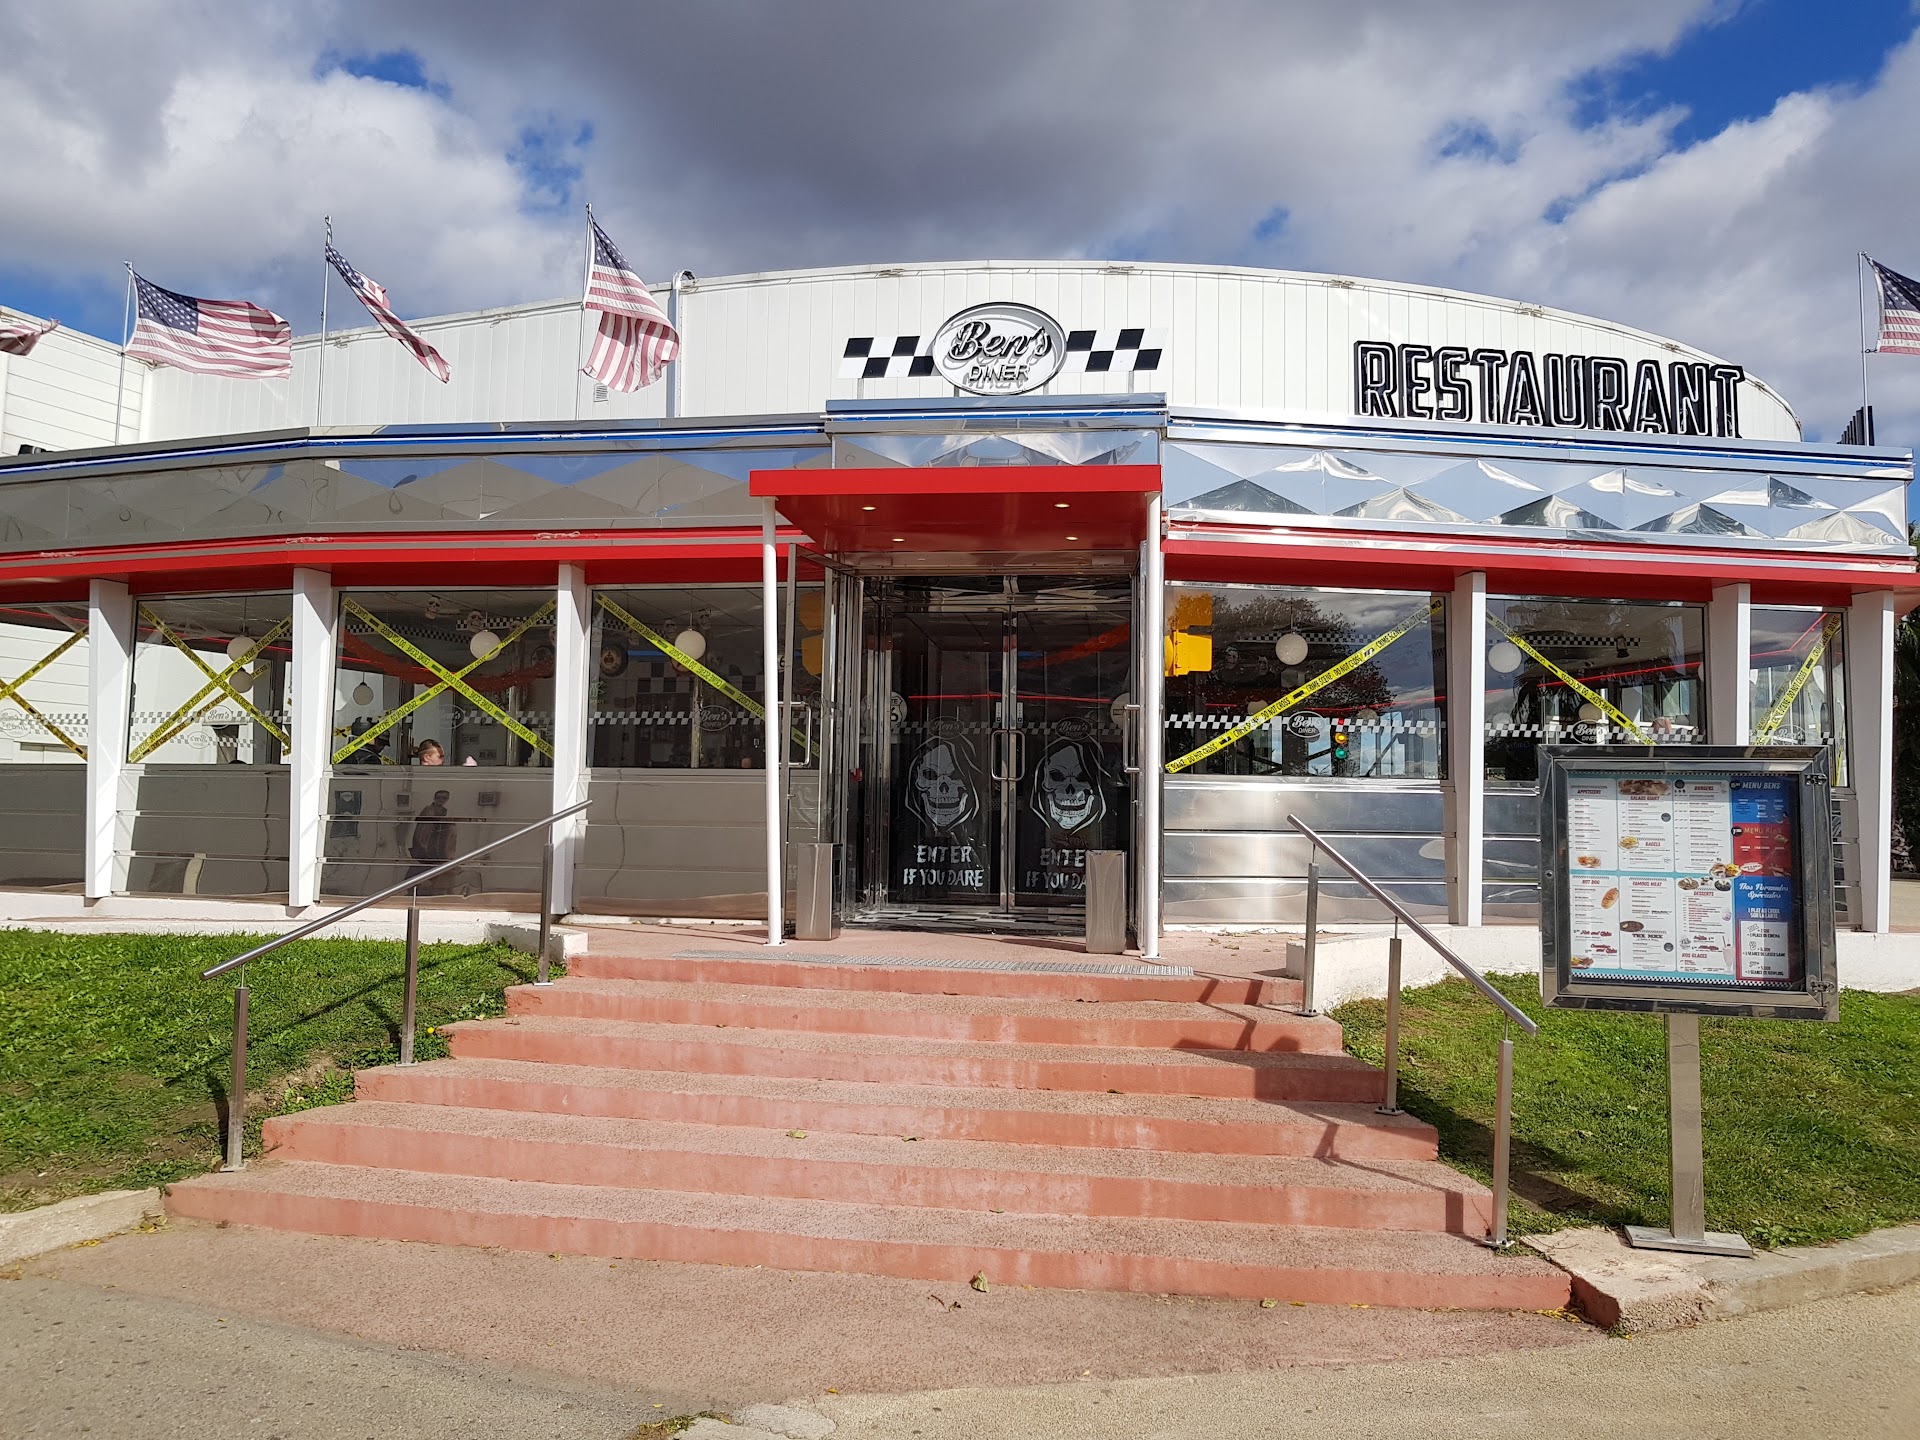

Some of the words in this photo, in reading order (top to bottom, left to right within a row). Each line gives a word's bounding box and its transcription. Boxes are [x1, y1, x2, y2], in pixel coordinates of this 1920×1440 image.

[949, 320, 1052, 361] Ben's
[969, 364, 1029, 382] DINER
[1354, 340, 1745, 439] RESTAURANT
[1193, 749, 1203, 759] NOT
[1201, 742, 1217, 755] CROSS
[1266, 704, 1278, 716] NOT
[1275, 696, 1290, 710] CROSS
[1304, 679, 1320, 693] CRIME
[1317, 672, 1333, 685] SCENE
[1338, 662, 1349, 672] NOT
[1346, 654, 1362, 668] CROSS
[1374, 635, 1390, 649] CRIME
[1386, 626, 1402, 640] SCENE
[1777, 697, 1790, 712] SCENE
[1790, 681, 1800, 692] NOT
[1795, 669, 1807, 684] CROSS
[208, 711, 230, 720] Ben's
[701, 710, 727, 721] Ben's
[1060, 721, 1088, 732] Ben's
[917, 845, 972, 864] ENTER
[1040, 848, 1086, 867] ENTE
[903, 868, 917, 885] IF
[919, 869, 945, 885] YOU
[947, 869, 984, 887] DARE
[1026, 871, 1040, 887] IF
[1042, 872, 1069, 888] YOU
[1072, 873, 1087, 889] DA
